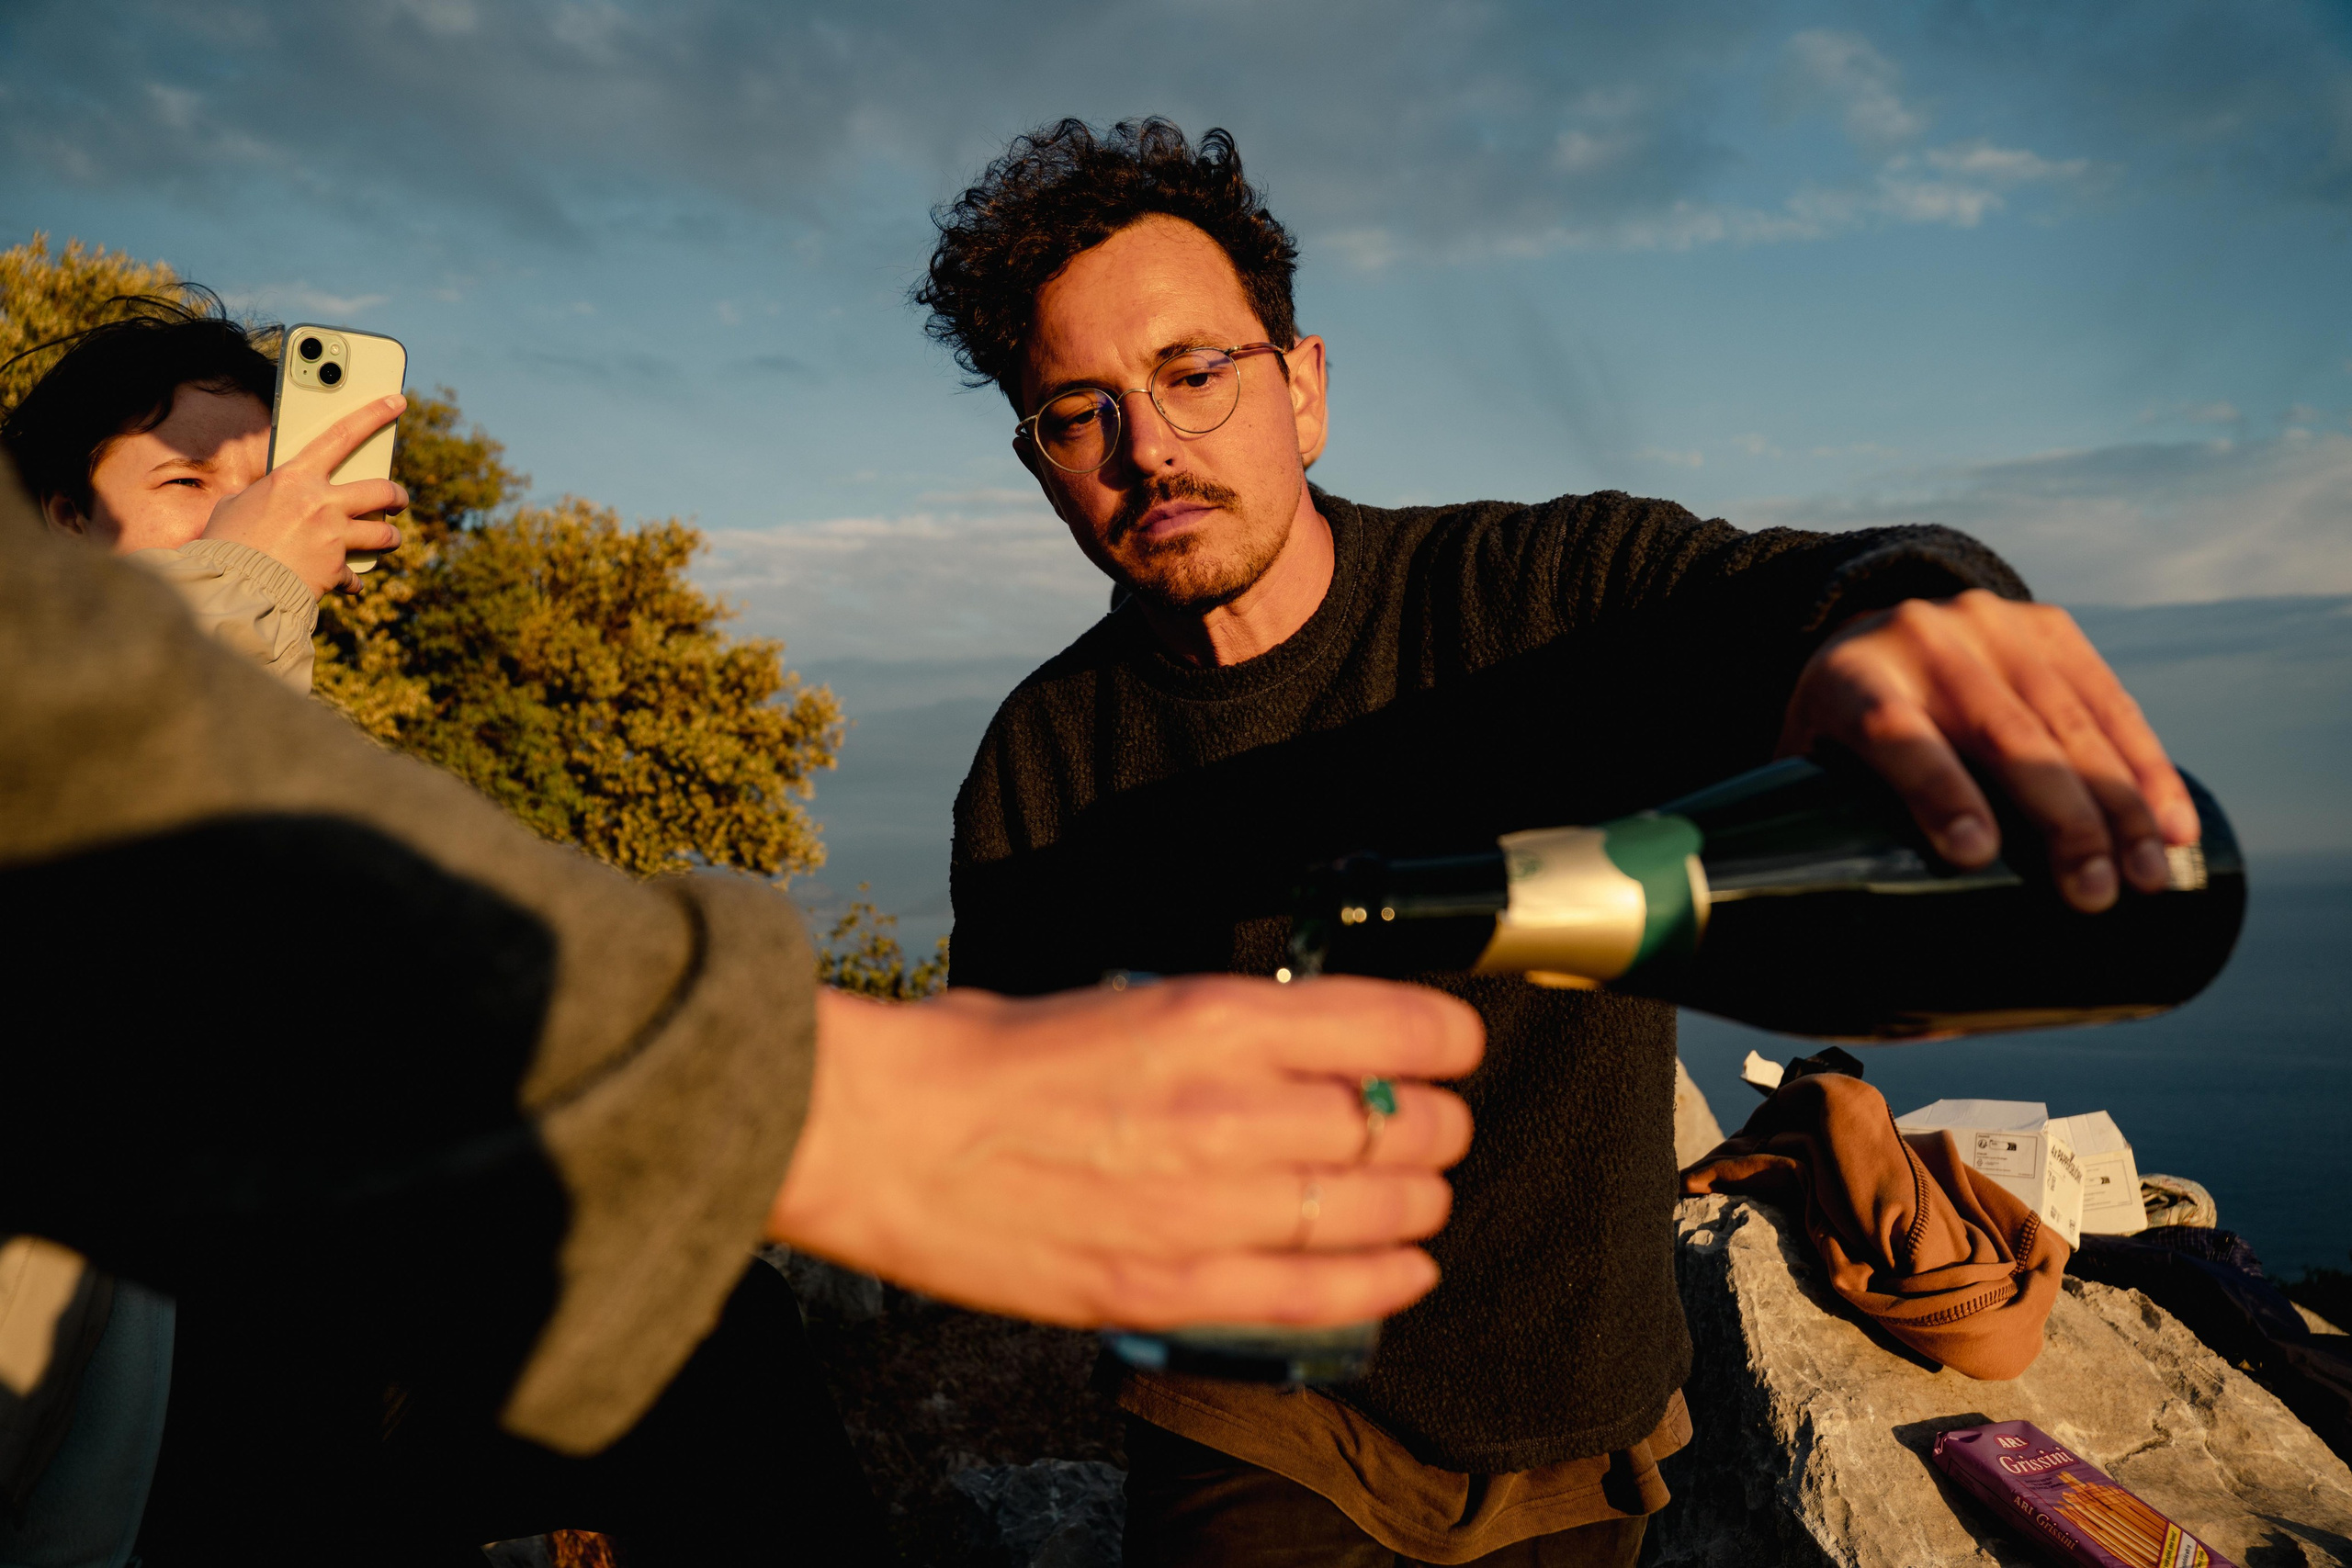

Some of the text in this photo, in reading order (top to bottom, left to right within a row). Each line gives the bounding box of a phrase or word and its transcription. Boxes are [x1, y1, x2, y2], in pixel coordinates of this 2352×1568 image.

[1996, 1437, 2028, 1448] ARI
[1999, 1446, 2074, 1473] Grissini
[2014, 1495, 2078, 1551] ARI Grissini
